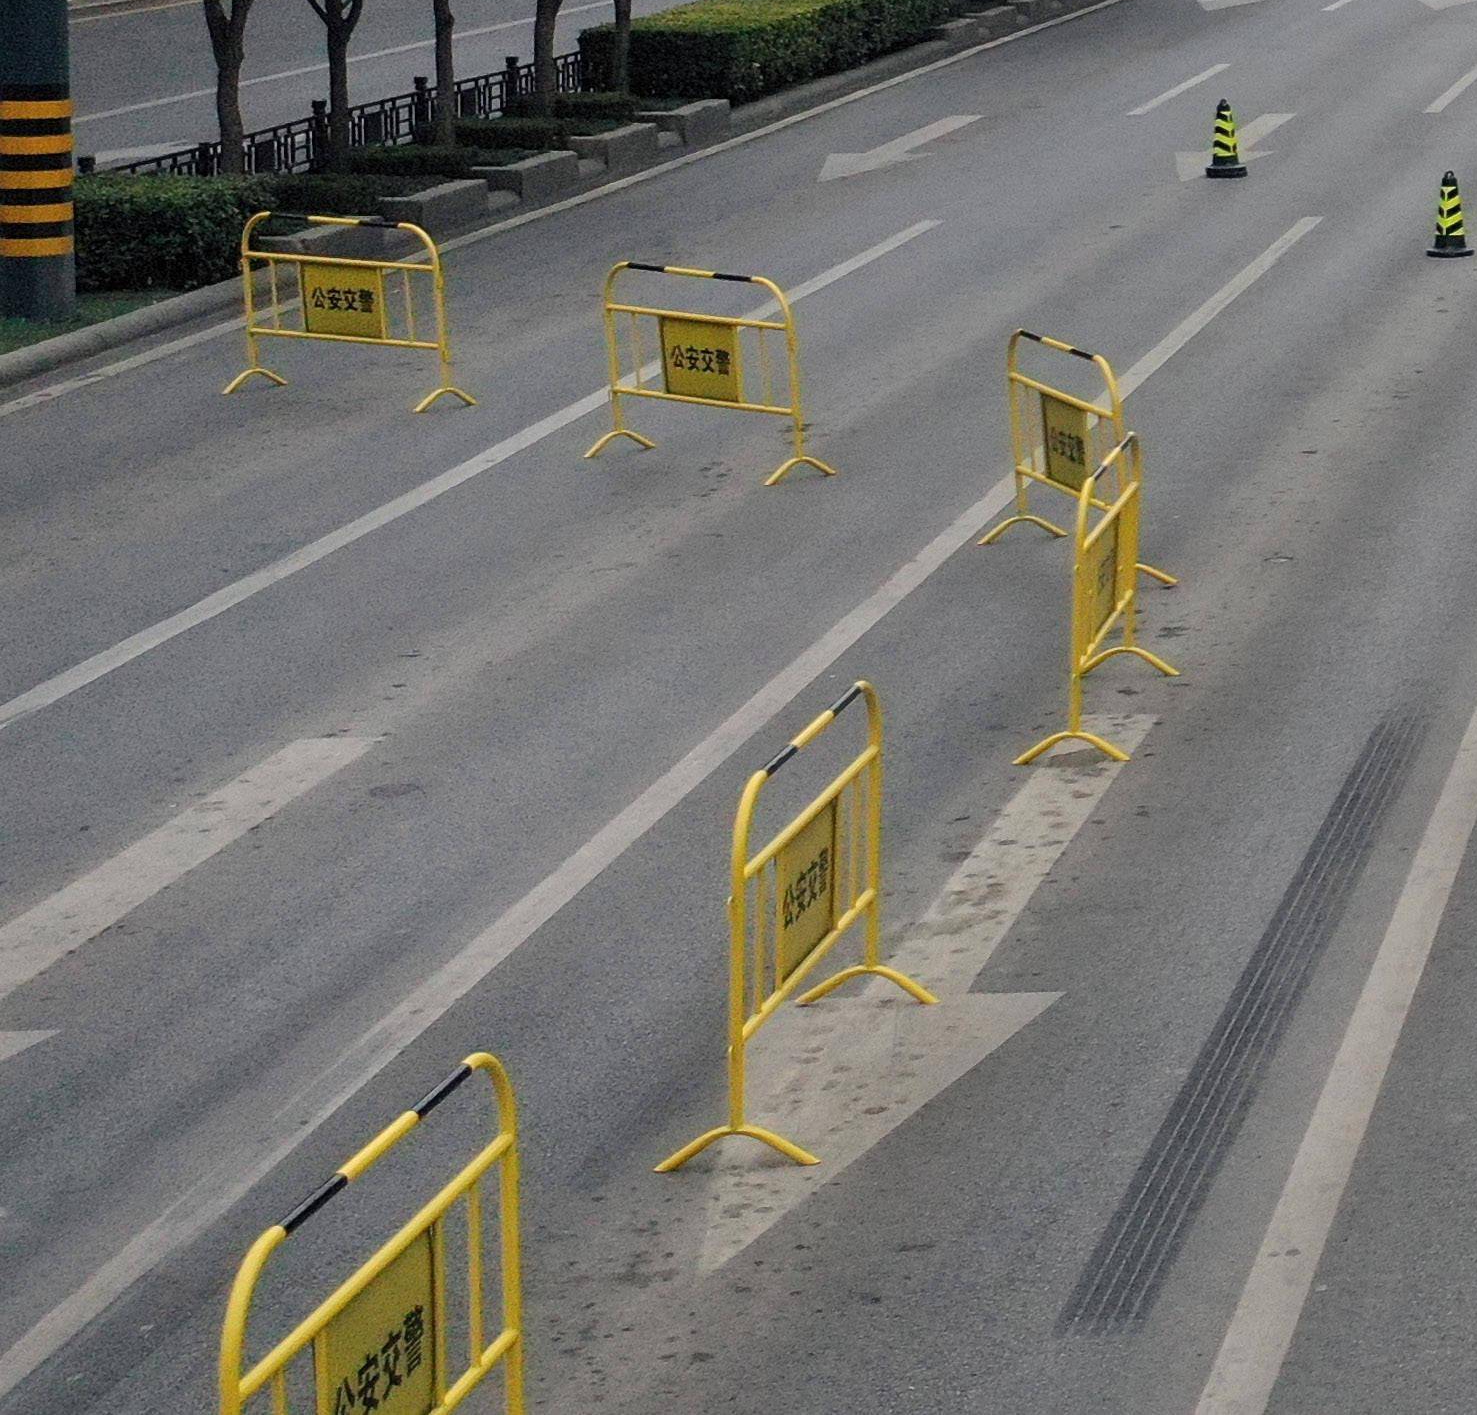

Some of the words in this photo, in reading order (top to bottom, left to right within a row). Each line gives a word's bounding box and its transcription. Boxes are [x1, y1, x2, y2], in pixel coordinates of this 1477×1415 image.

[311, 286, 374, 314] 公安交警
[671, 344, 731, 376] 公安交警
[782, 847, 829, 930] 公安交警
[334, 1304, 425, 1415] 公安交警
